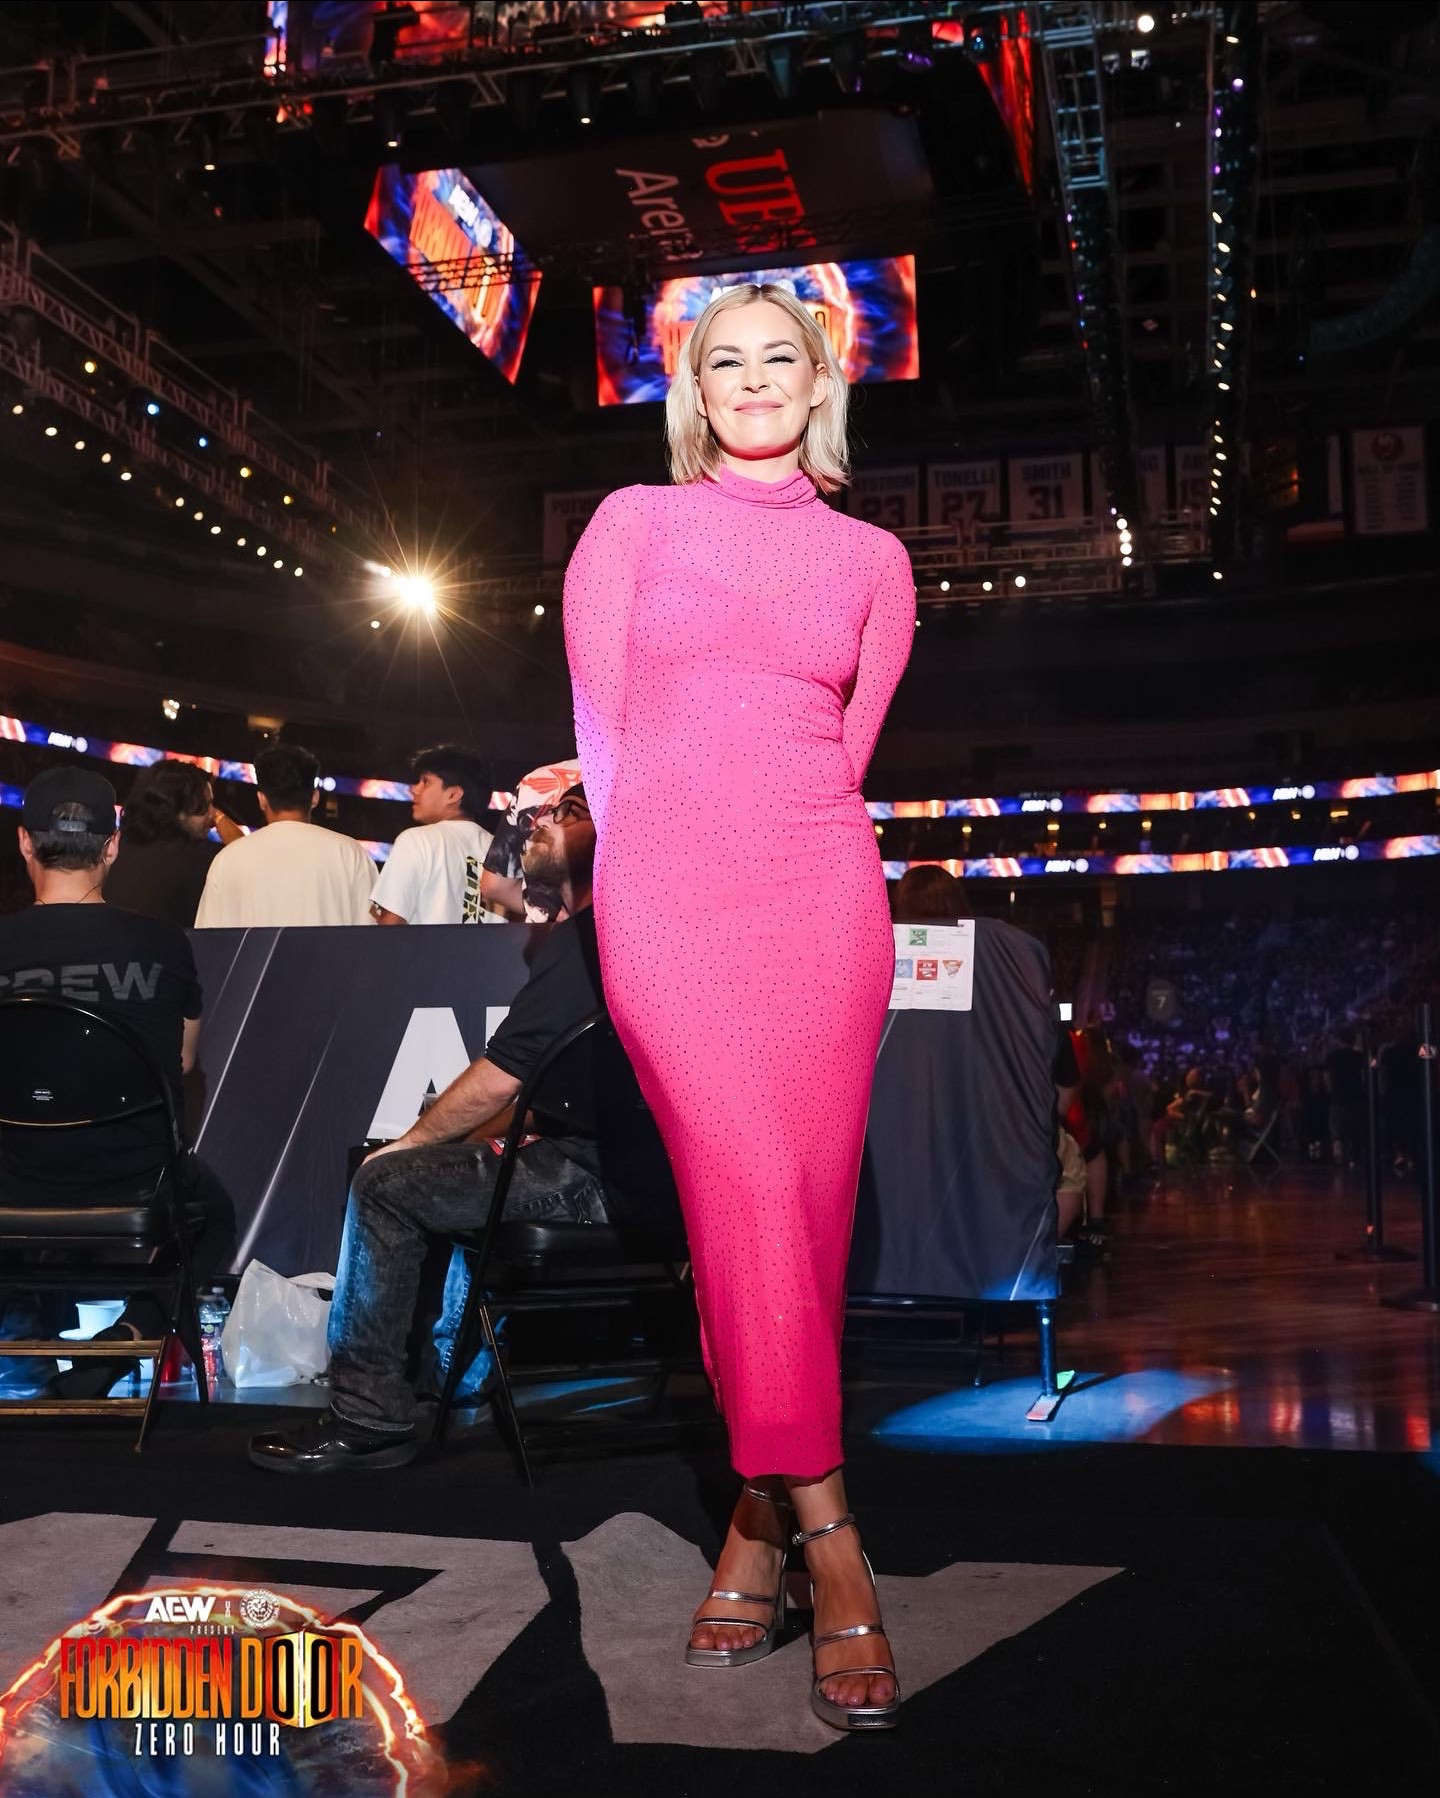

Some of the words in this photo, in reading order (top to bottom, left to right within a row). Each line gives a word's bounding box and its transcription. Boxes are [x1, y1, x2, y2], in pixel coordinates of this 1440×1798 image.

[934, 467, 996, 487] TONELLI
[1022, 463, 1071, 482] SMITH
[941, 490, 986, 524] 27
[1028, 484, 1064, 520] 31
